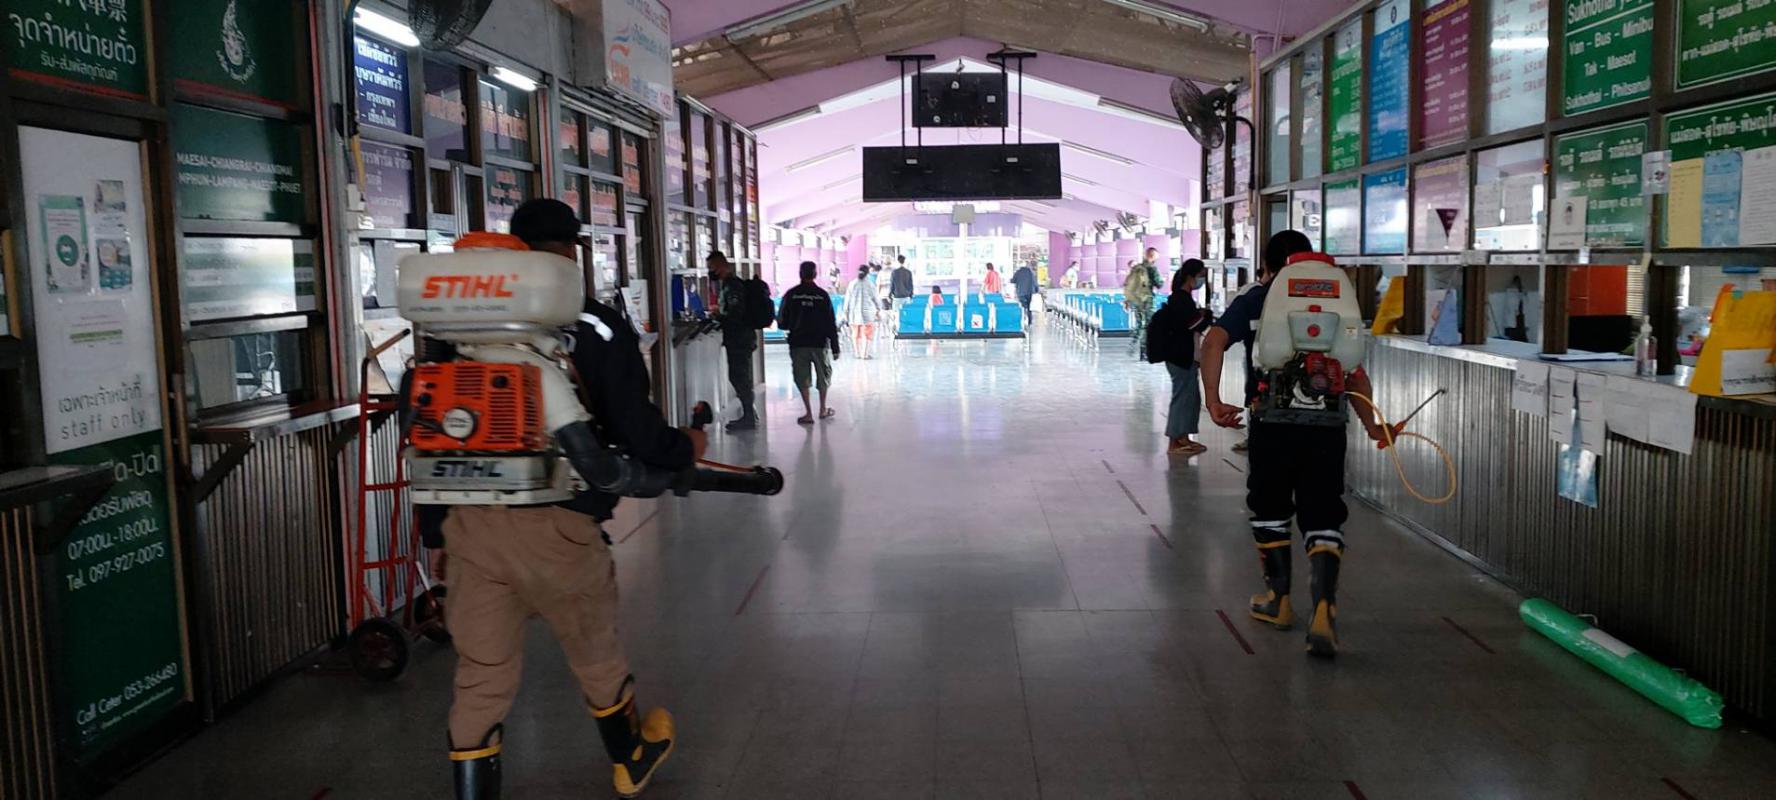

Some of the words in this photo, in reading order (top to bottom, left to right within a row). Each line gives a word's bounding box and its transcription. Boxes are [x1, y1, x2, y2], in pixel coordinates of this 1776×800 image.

[9, 11, 137, 66] จุดจำหน่ายตั๋ว
[1569, 40, 1585, 56] Van
[1594, 31, 1612, 48] Bus
[1584, 61, 1598, 77] Tak
[1607, 50, 1637, 71] Maesot
[1566, 88, 1602, 110] Sukhothai
[419, 274, 513, 299] STIHL
[58, 374, 142, 413] เฉพาะเจ้าหน้าที่
[61, 414, 102, 440] staff
[112, 407, 146, 429] only
[432, 460, 503, 478] STIHL
[77, 702, 97, 725] Call
